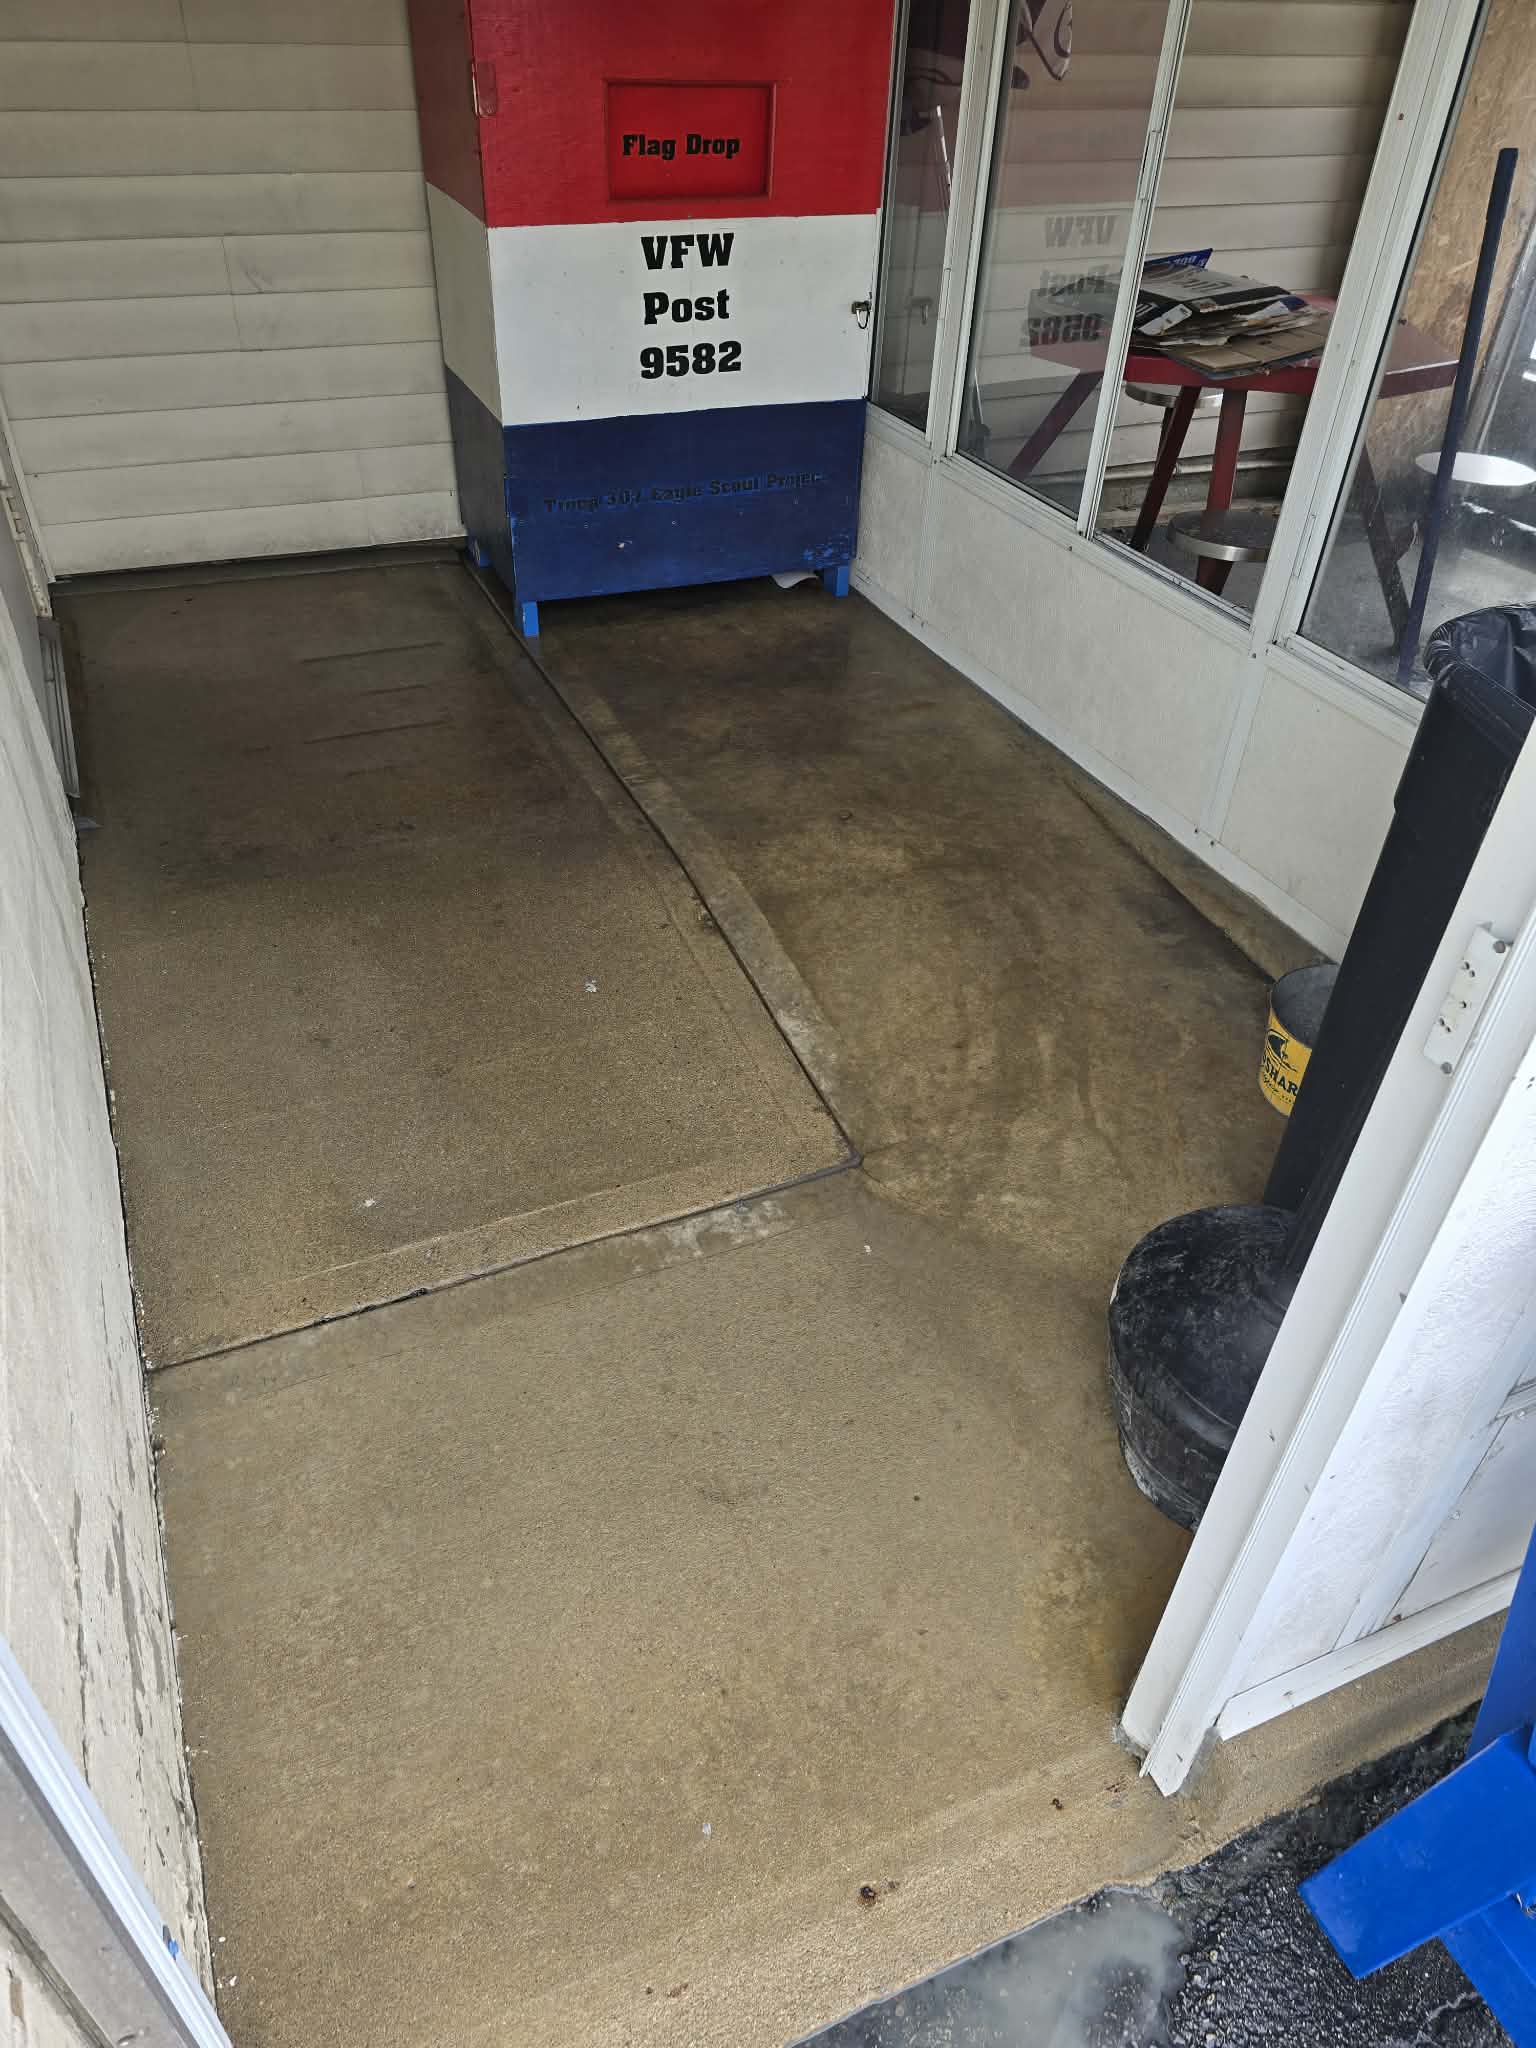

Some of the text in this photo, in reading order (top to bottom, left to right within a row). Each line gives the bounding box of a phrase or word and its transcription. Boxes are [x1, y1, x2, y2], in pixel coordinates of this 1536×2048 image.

[622, 133, 740, 160] Flag Drop
[640, 232, 735, 270] VFW
[643, 289, 730, 325] Post
[639, 341, 742, 380] 9582
[651, 482, 704, 502] Eagle
[711, 475, 759, 497] Scout
